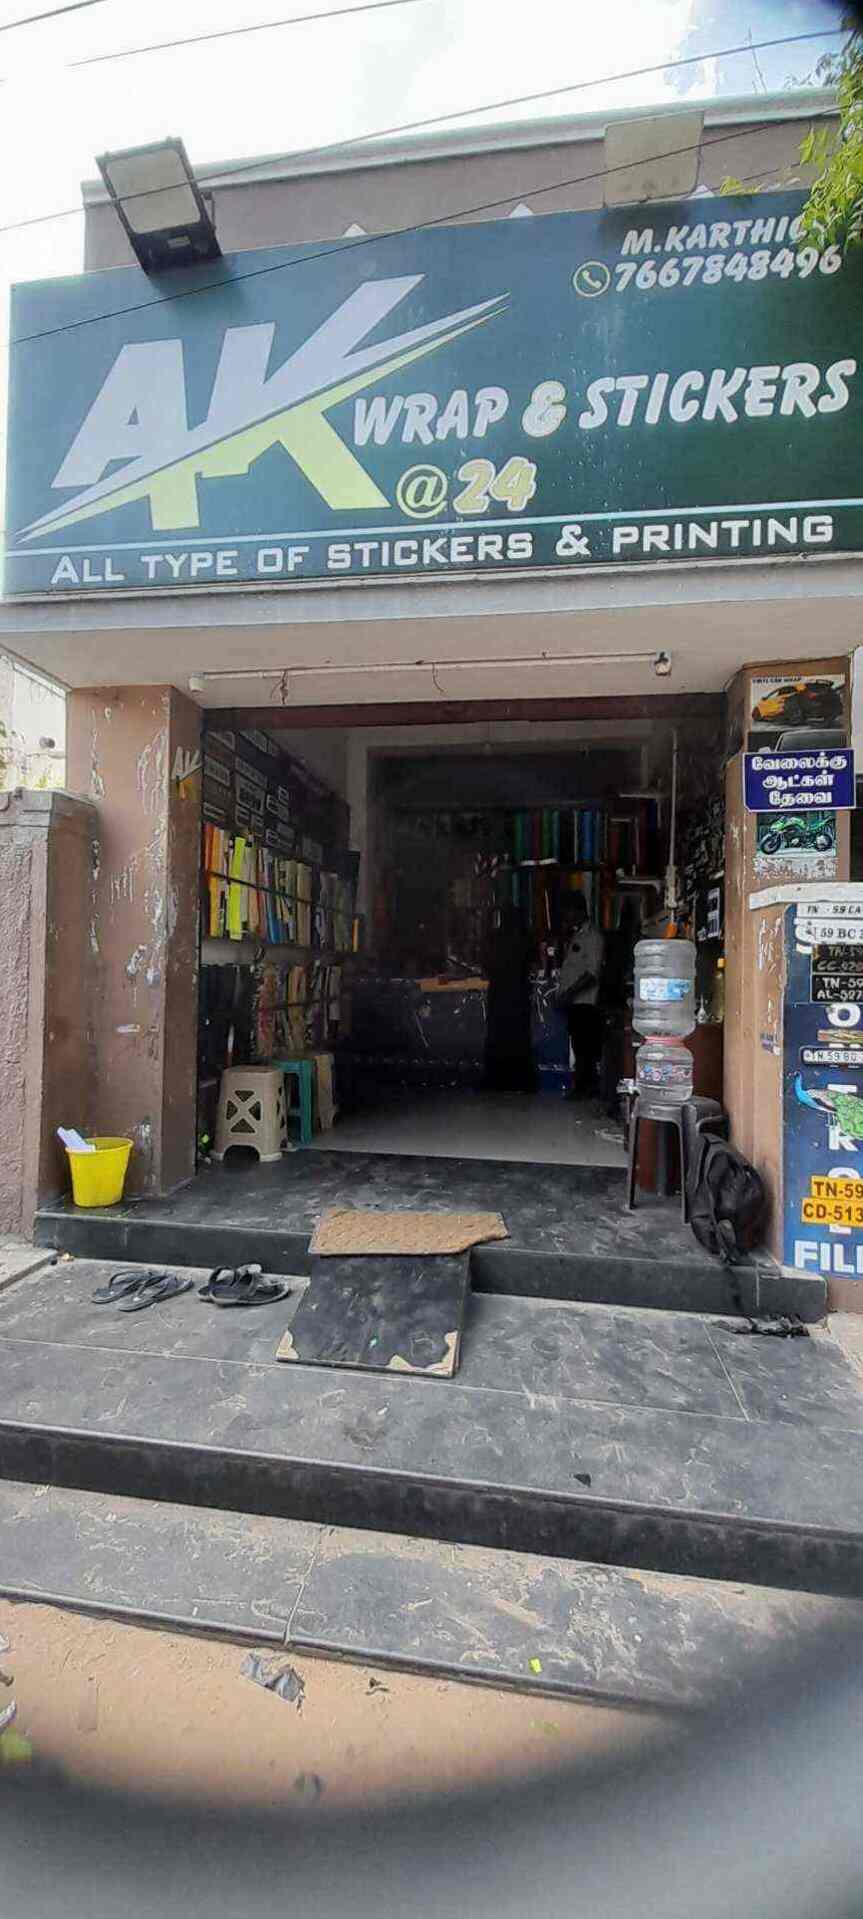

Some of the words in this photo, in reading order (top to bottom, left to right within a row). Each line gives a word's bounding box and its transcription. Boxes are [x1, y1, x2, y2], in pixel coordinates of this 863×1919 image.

[621, 214, 827, 256] M.KARTHIC
[615, 245, 842, 293] 7667848496
[50, 272, 426, 532] AK
[353, 386, 509, 446] WRAP
[521, 380, 567, 438] &
[578, 359, 857, 430] STICKERS
[50, 555, 125, 584] ALL
[141, 549, 239, 579] TYPE
[256, 545, 310, 574] OF
[326, 532, 534, 570] STICKERS
[555, 524, 592, 557] &
[612, 514, 834, 554] PRINTING
[751, 751, 848, 772] வேலைக்கு
[762, 770, 835, 791] ஆட்கள்
[768, 790, 833, 808] தேவை
[820, 928, 834, 938] 59
[814, 1180, 863, 1198] TN-59
[803, 1202, 863, 1223] CD-513
[794, 1239, 863, 1275] FIL
